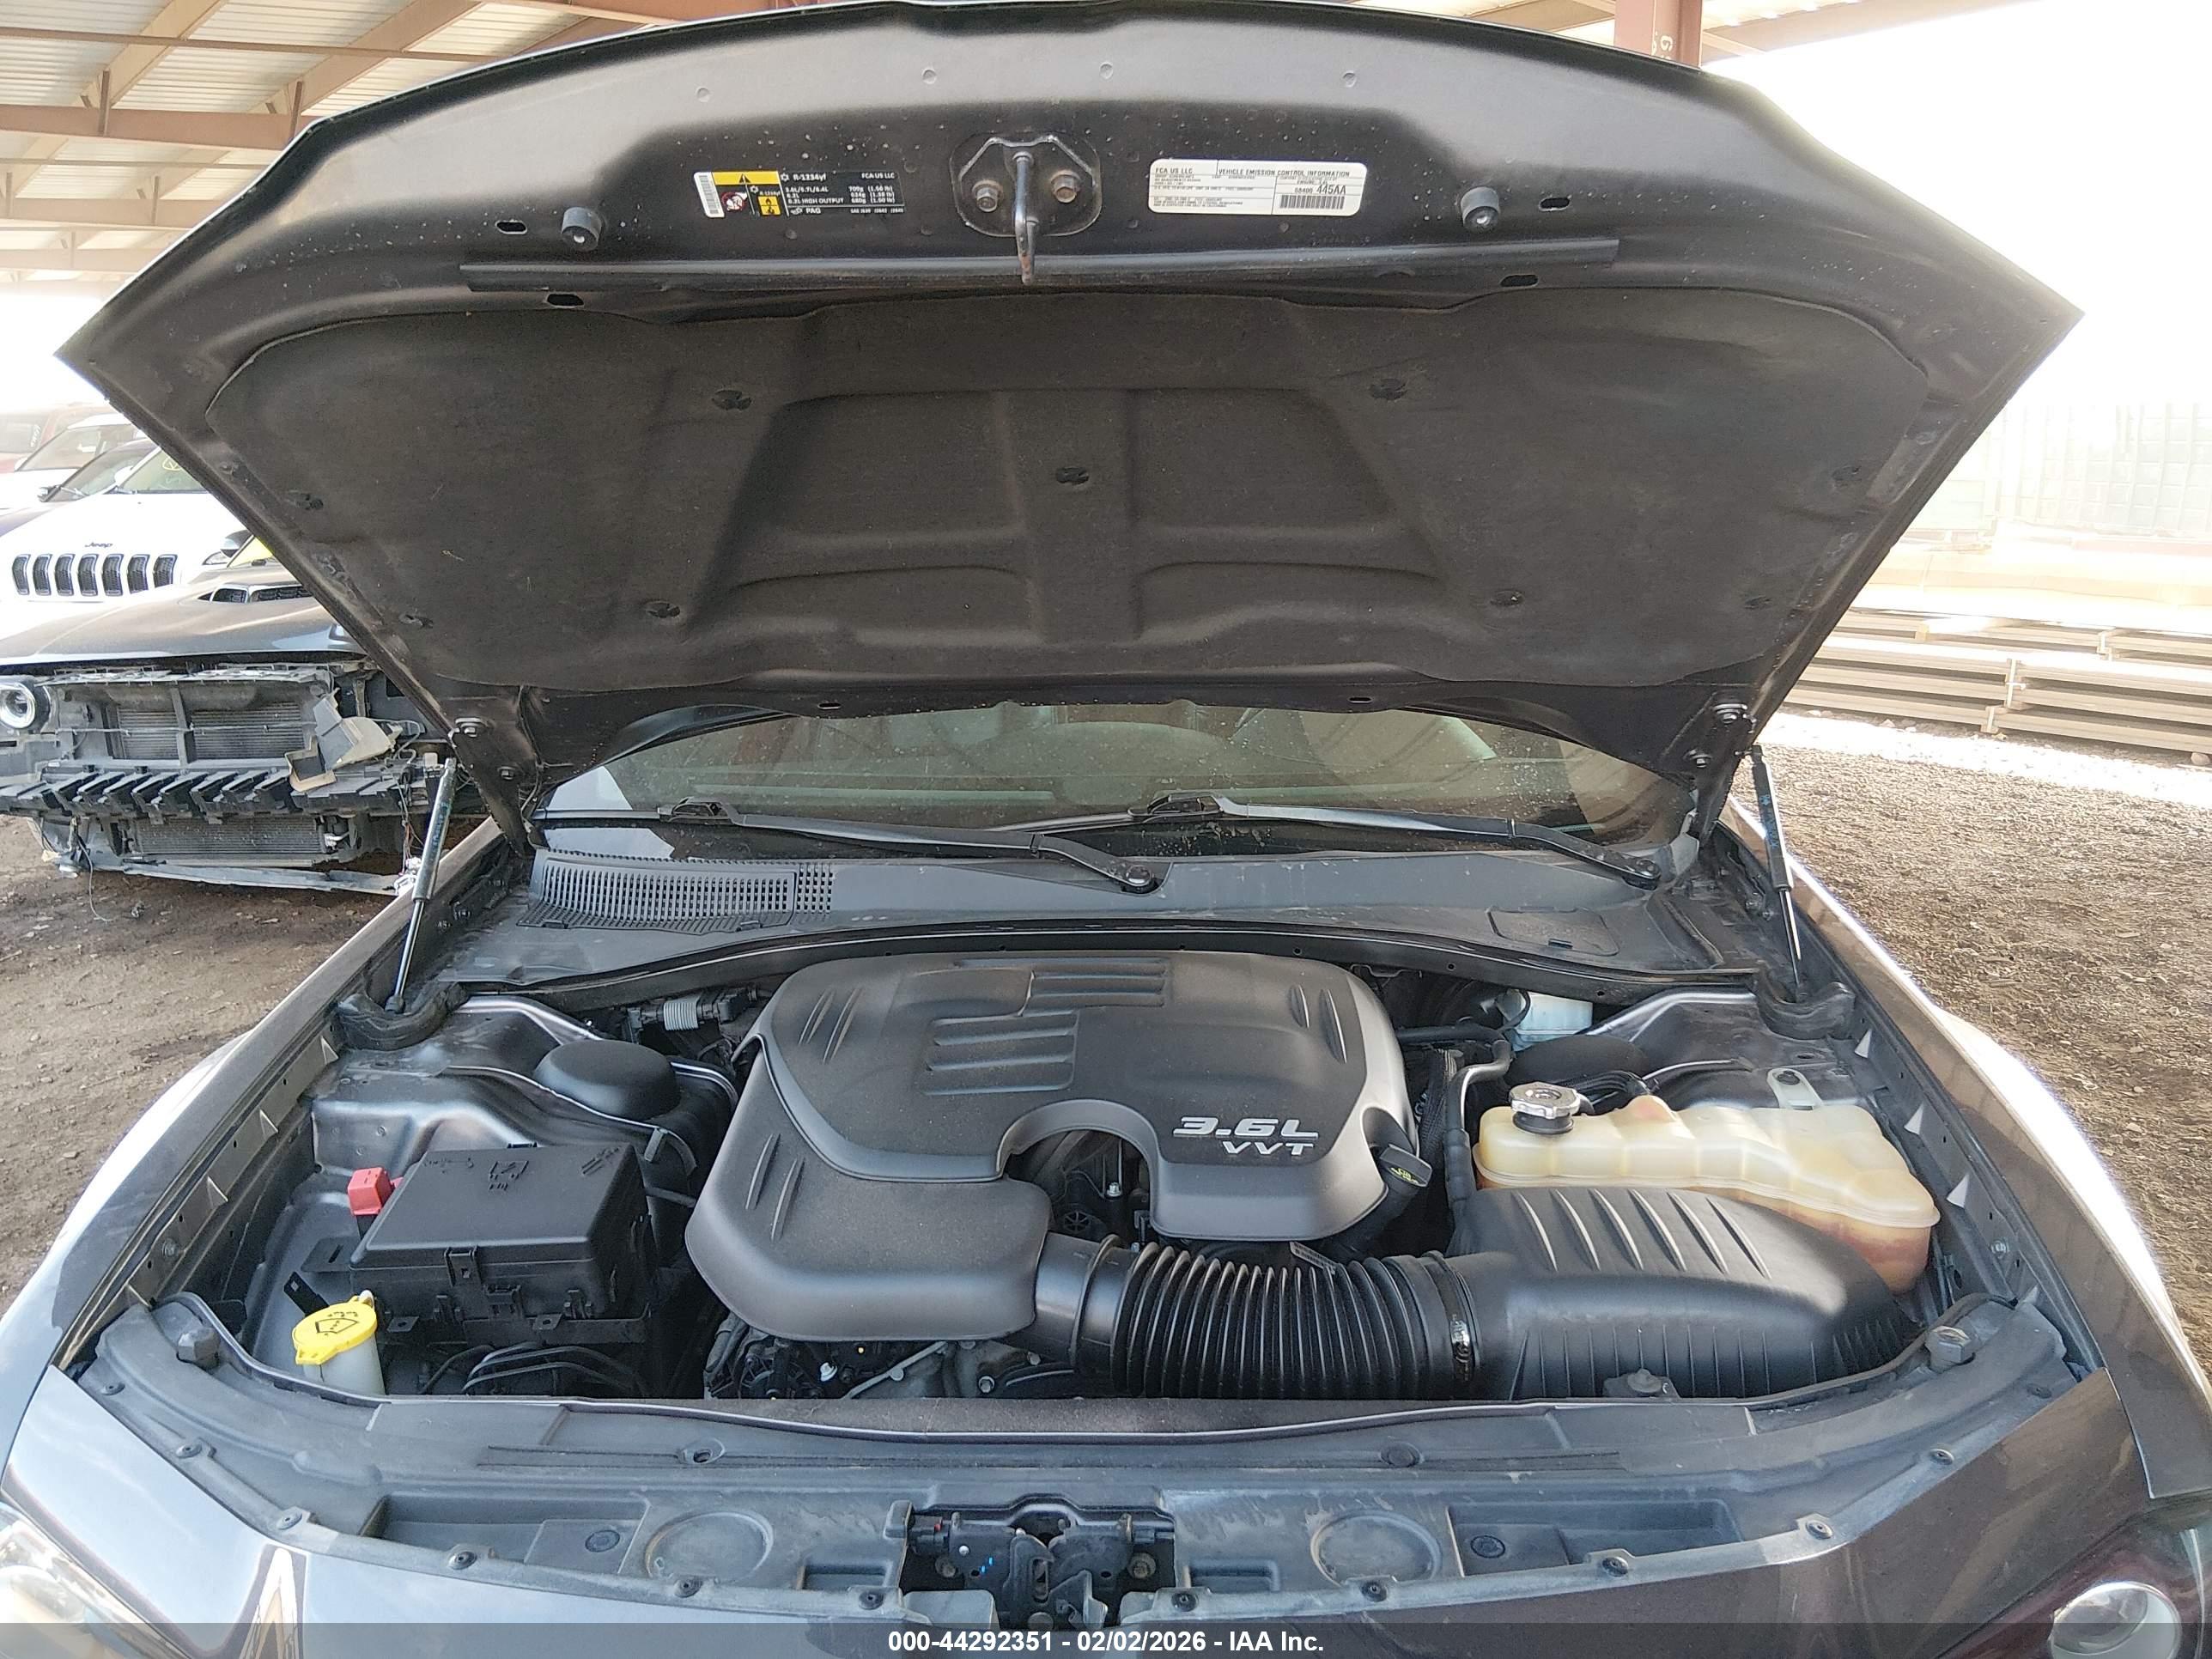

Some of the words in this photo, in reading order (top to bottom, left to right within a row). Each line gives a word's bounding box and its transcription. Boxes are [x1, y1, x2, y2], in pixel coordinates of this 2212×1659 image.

[793, 173, 827, 182] R-1234yf
[1316, 185, 1346, 195] 445AA
[1173, 1116, 1319, 1139] 3.6L
[1222, 1140, 1315, 1156] VVT
